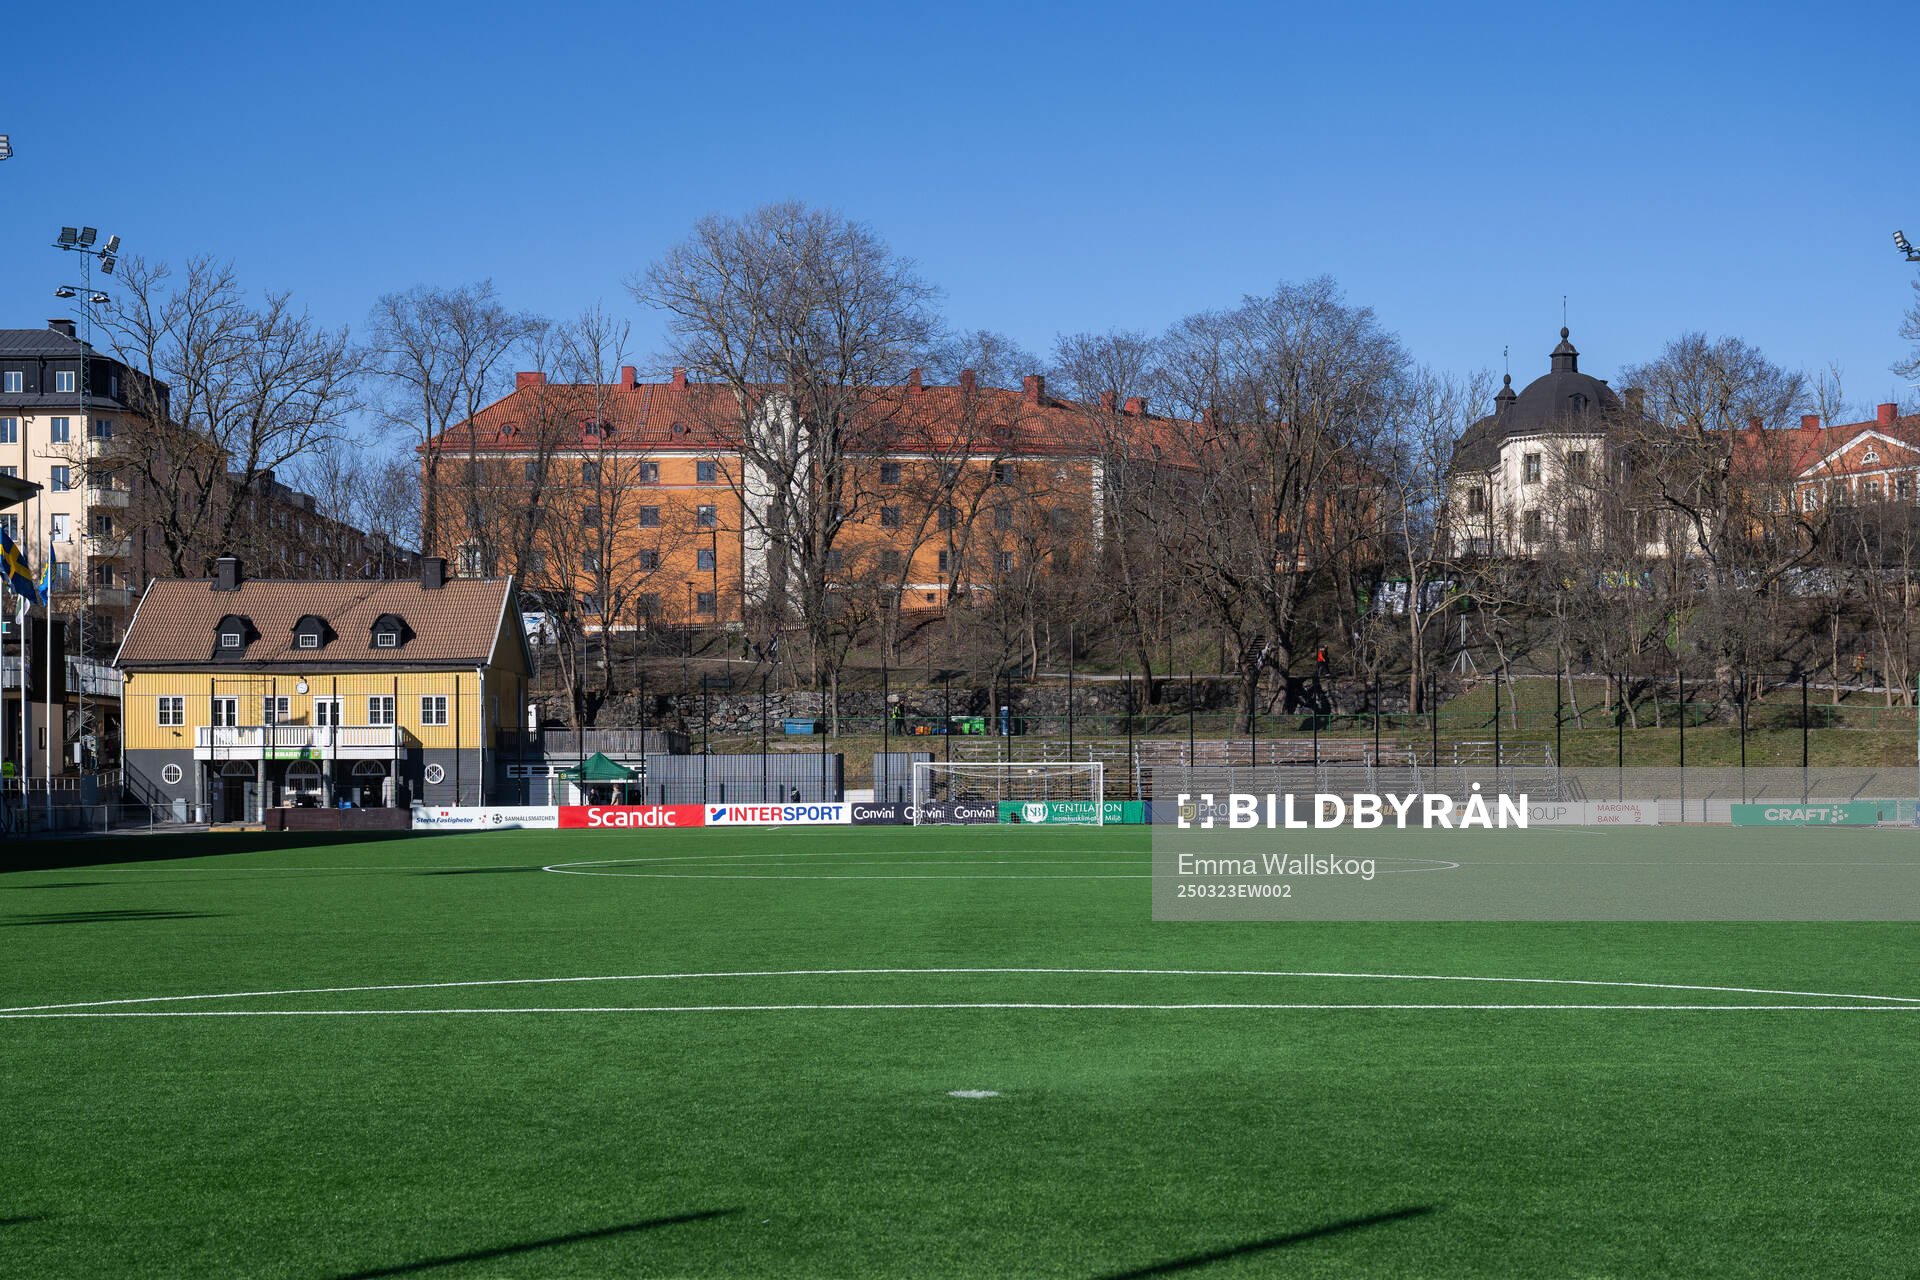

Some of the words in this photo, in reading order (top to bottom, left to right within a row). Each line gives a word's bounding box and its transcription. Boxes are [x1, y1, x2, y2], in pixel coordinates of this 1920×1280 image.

[729, 806, 843, 821] INTERSPORT
[853, 806, 895, 820] Convini
[954, 806, 995, 819] Convini
[1052, 803, 1122, 813] VENTILATON
[1764, 808, 1830, 821] CRAFT
[416, 817, 435, 825] Stena
[436, 817, 474, 825] Fastigheter
[587, 807, 676, 827] Scandic
[1597, 815, 1620, 823] BANK
